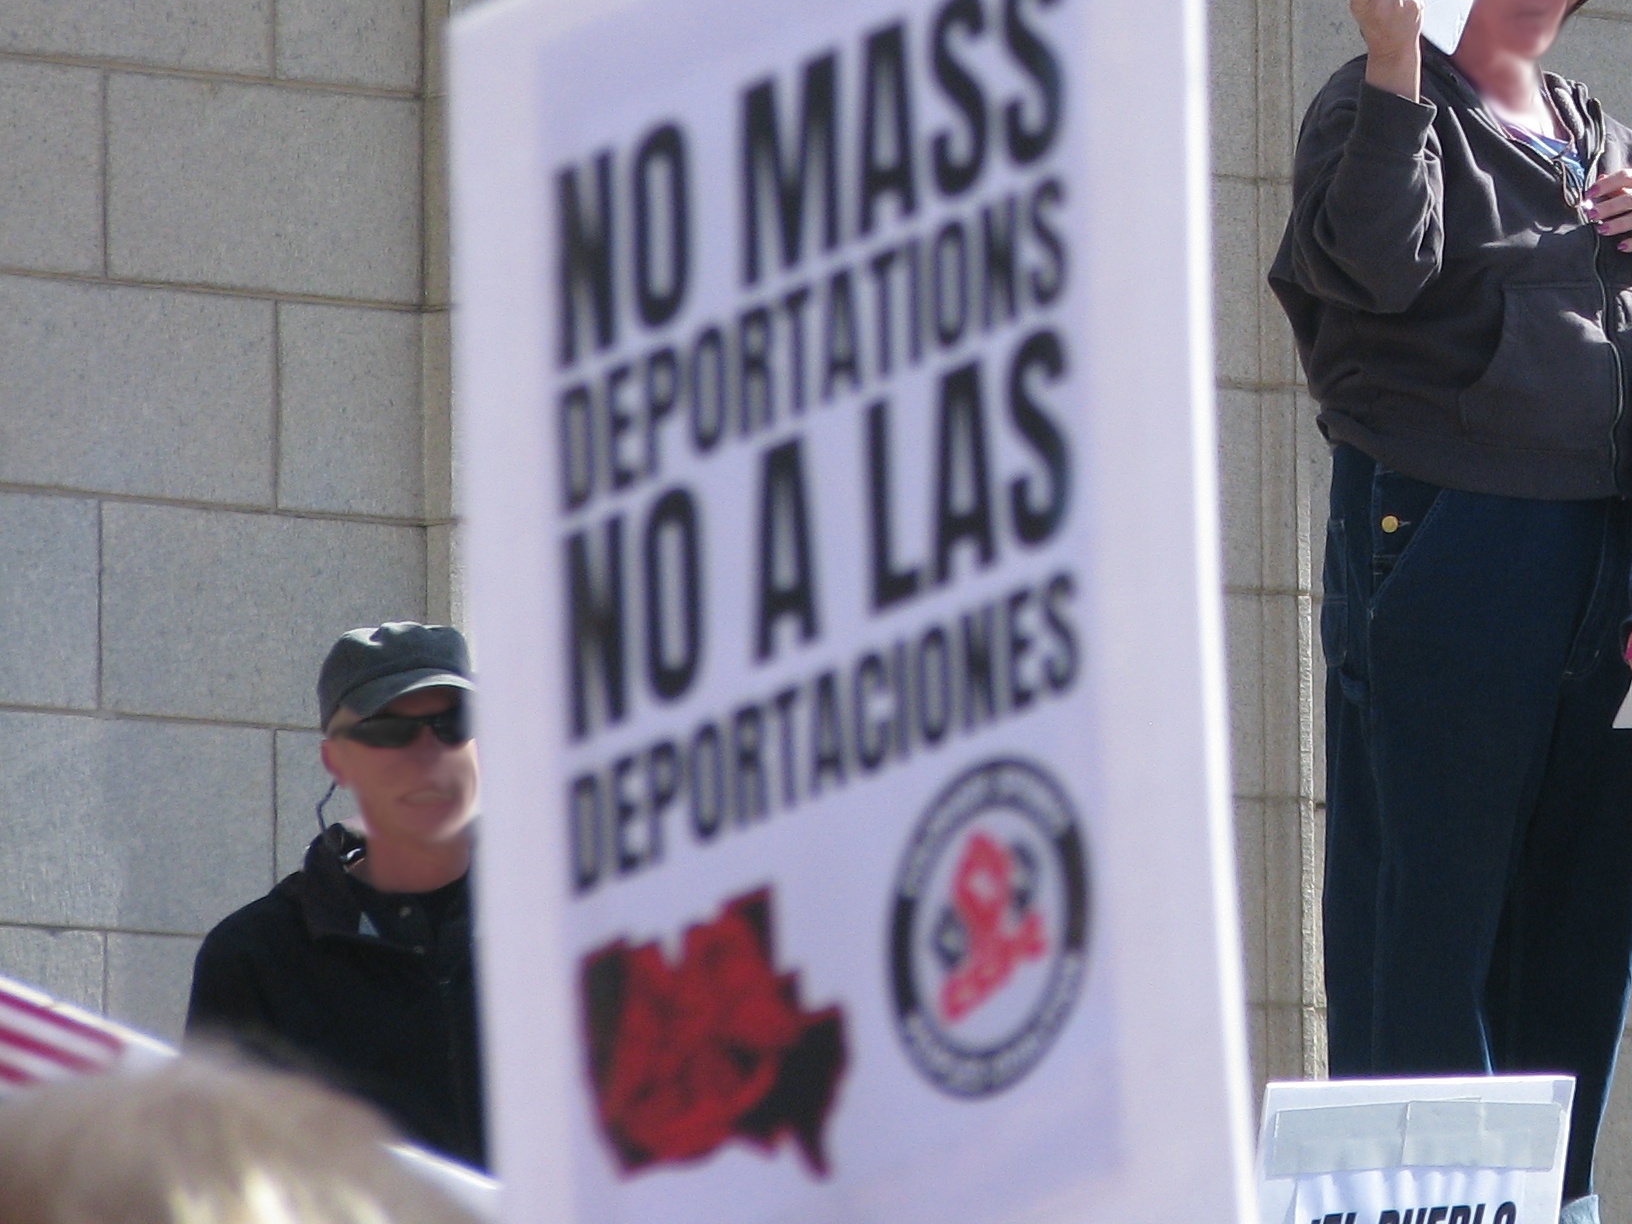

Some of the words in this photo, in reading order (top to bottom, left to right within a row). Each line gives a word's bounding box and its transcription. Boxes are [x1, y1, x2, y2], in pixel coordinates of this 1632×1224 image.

[555, 116, 691, 371] NO
[558, 175, 1068, 514] DEPORTATIONS
[564, 485, 702, 743] NO
[754, 433, 818, 664] A
[865, 328, 1073, 614] LAS
[570, 568, 1081, 898] DEPORTACIONES
